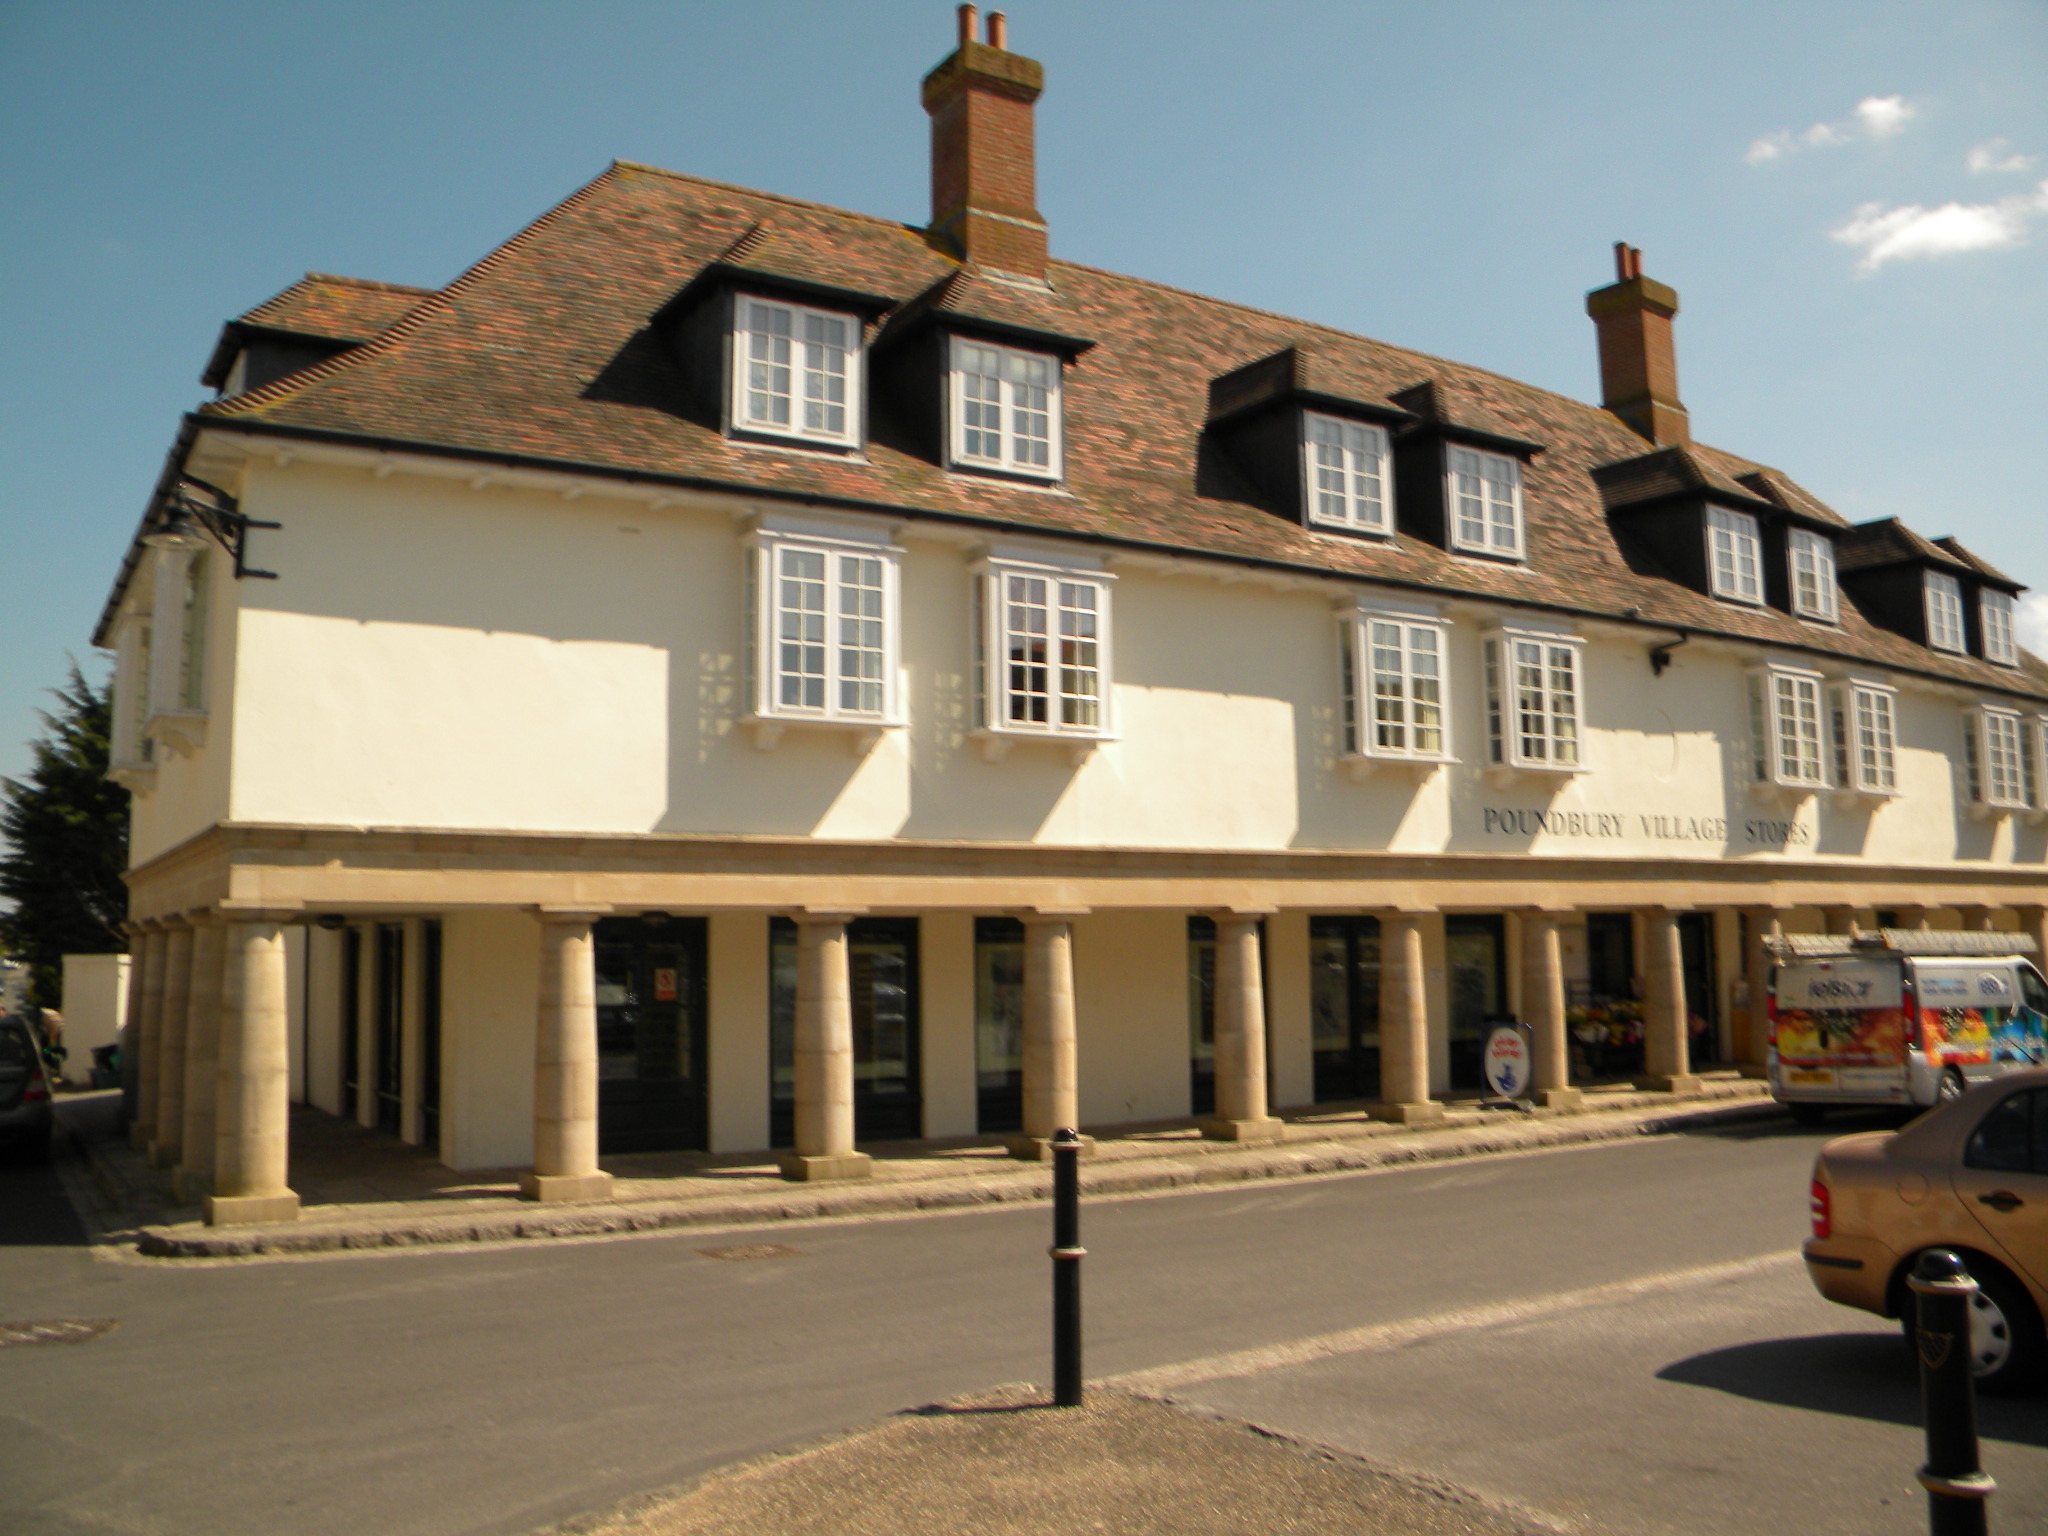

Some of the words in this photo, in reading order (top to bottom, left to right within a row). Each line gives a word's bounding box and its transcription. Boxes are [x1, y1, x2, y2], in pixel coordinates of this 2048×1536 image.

[1483, 807, 1624, 838] POUNDBURY
[1639, 814, 1728, 842] VILLAGE
[1745, 819, 1809, 846] STORES
